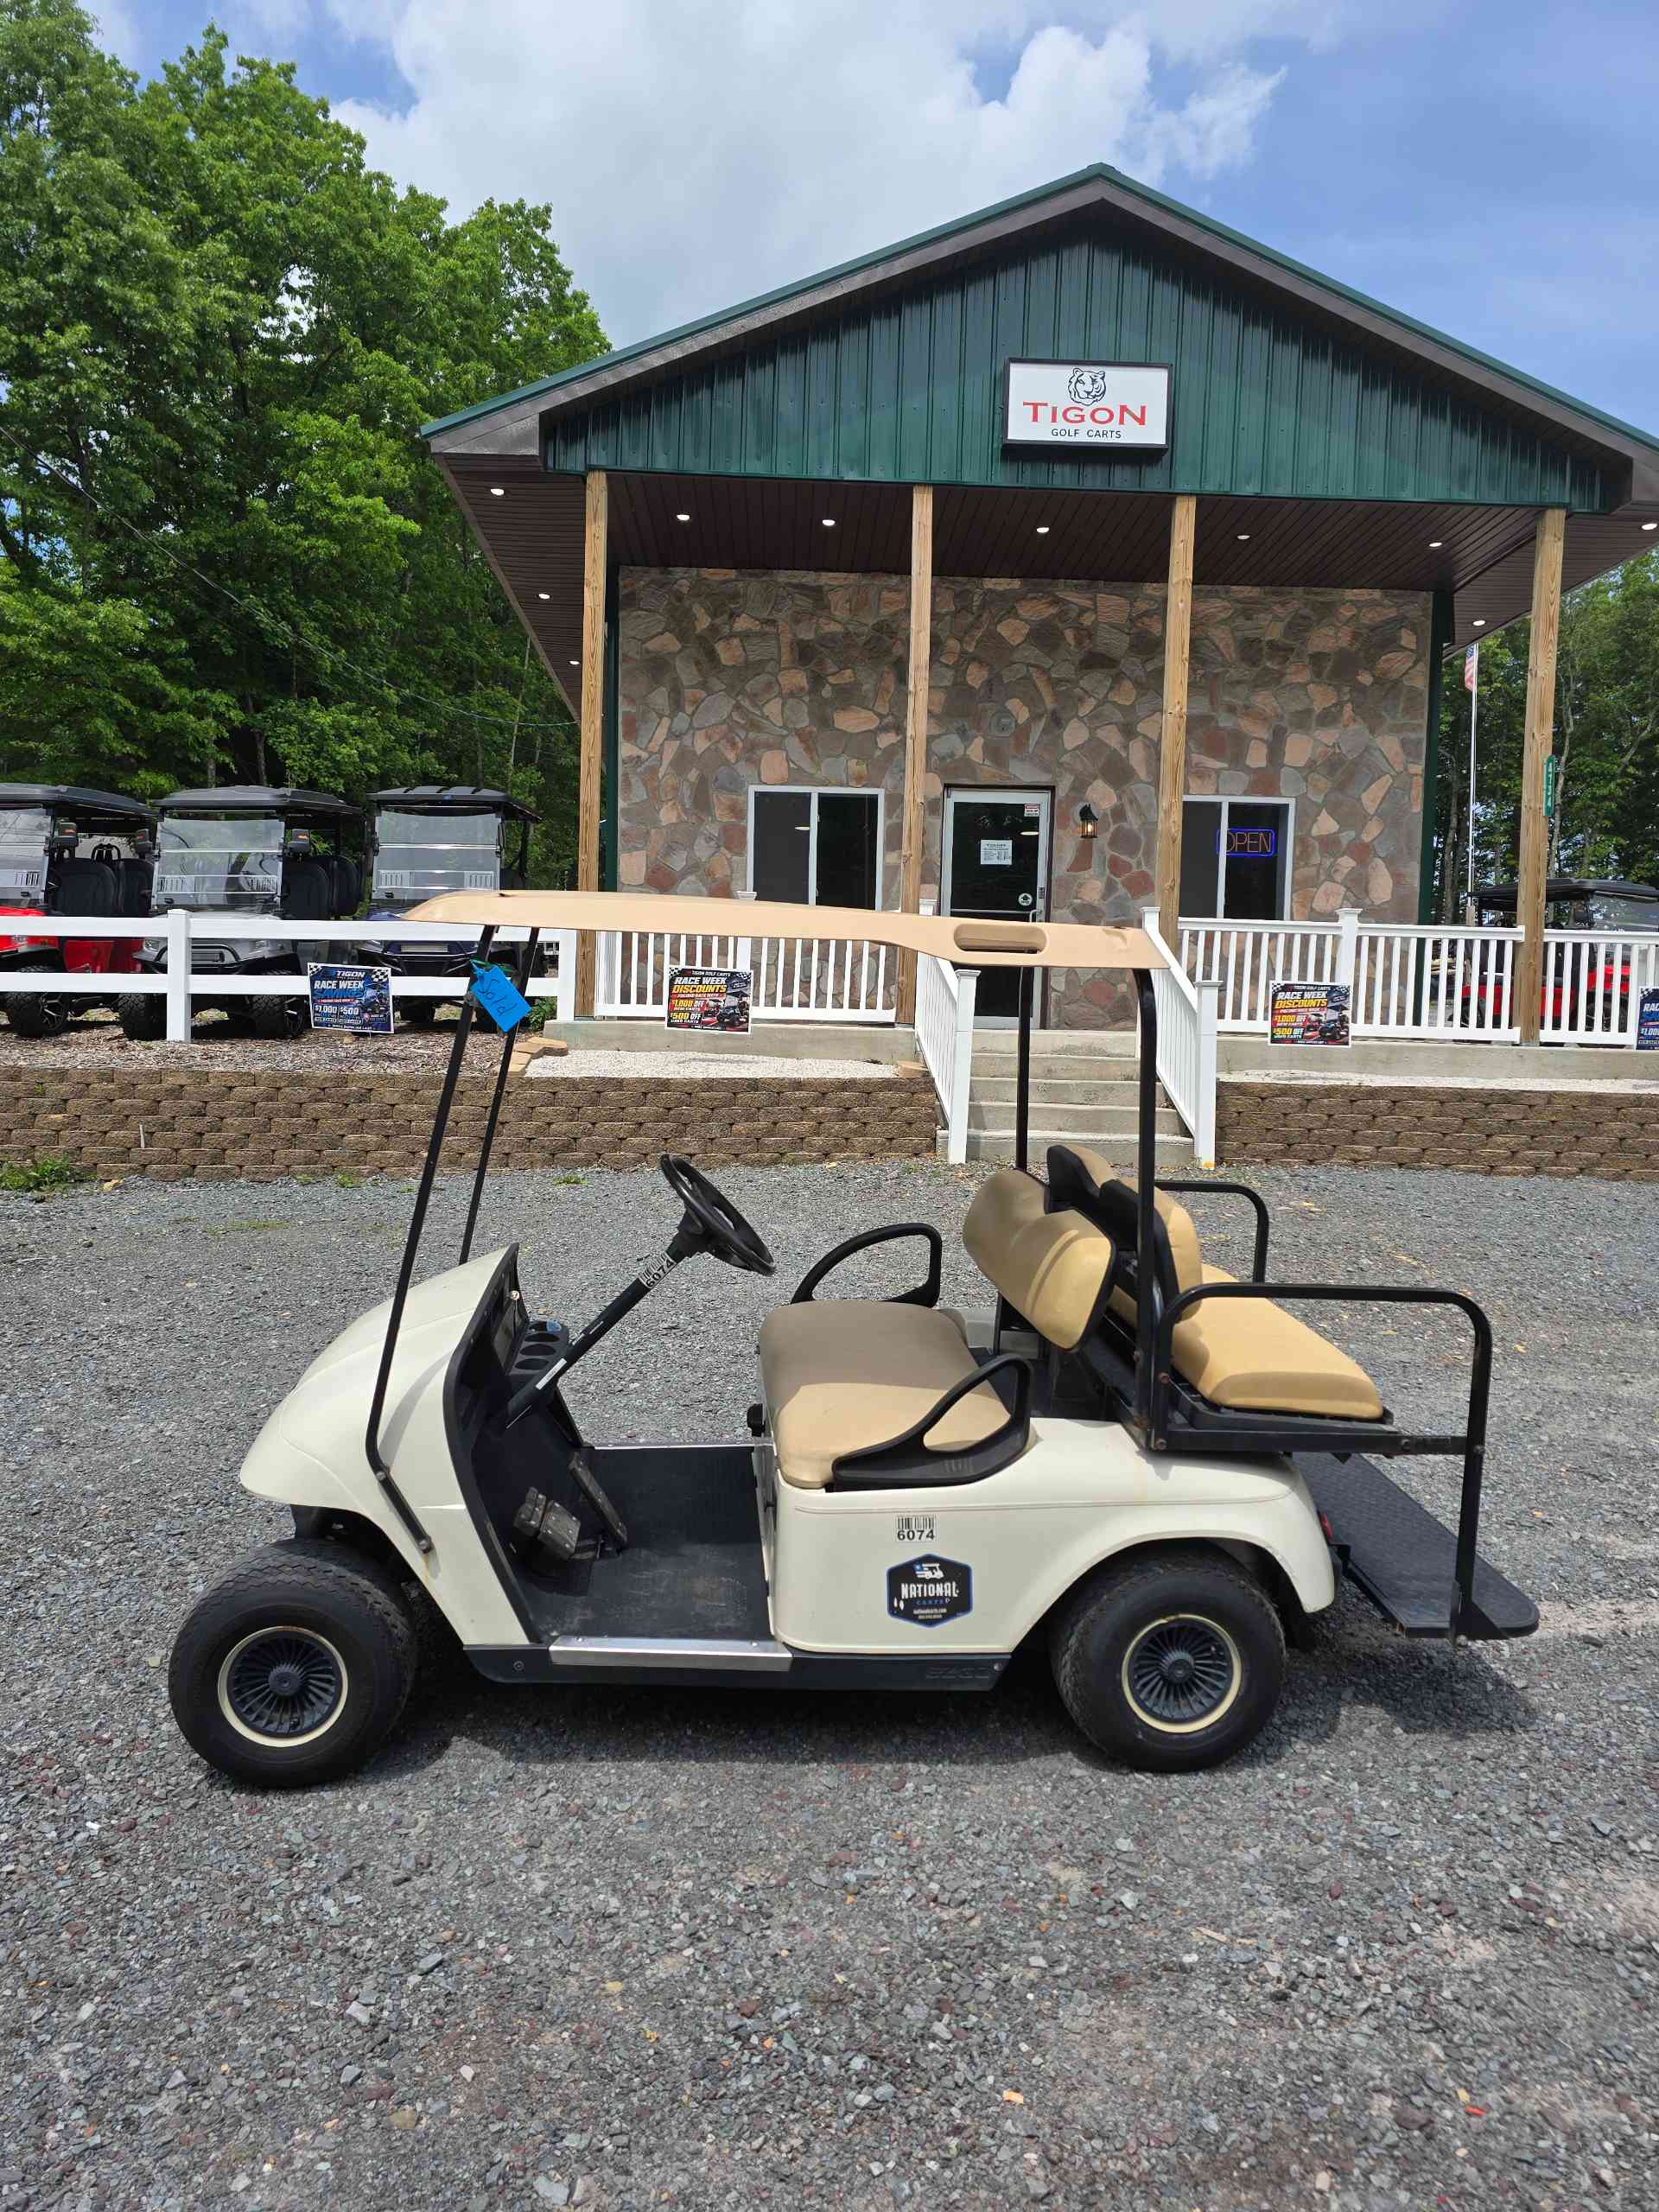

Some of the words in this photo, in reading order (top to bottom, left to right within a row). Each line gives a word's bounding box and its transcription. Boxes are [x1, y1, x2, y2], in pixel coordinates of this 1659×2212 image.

[1022, 402, 1147, 425] TIGON
[1051, 429, 1079, 437] GOLF
[1087, 429, 1122, 439] CARTS
[1226, 832, 1271, 852] OPEN
[339, 981, 365, 989] WEEK
[476, 978, 518, 1017] Sold
[1274, 999, 1328, 1008] DISCOUNTS
[340, 1007, 359, 1015] $500
[646, 1258, 675, 1287] 6074
[897, 1529, 935, 1541] 6074
[900, 1580, 958, 1599] NATIONAL
